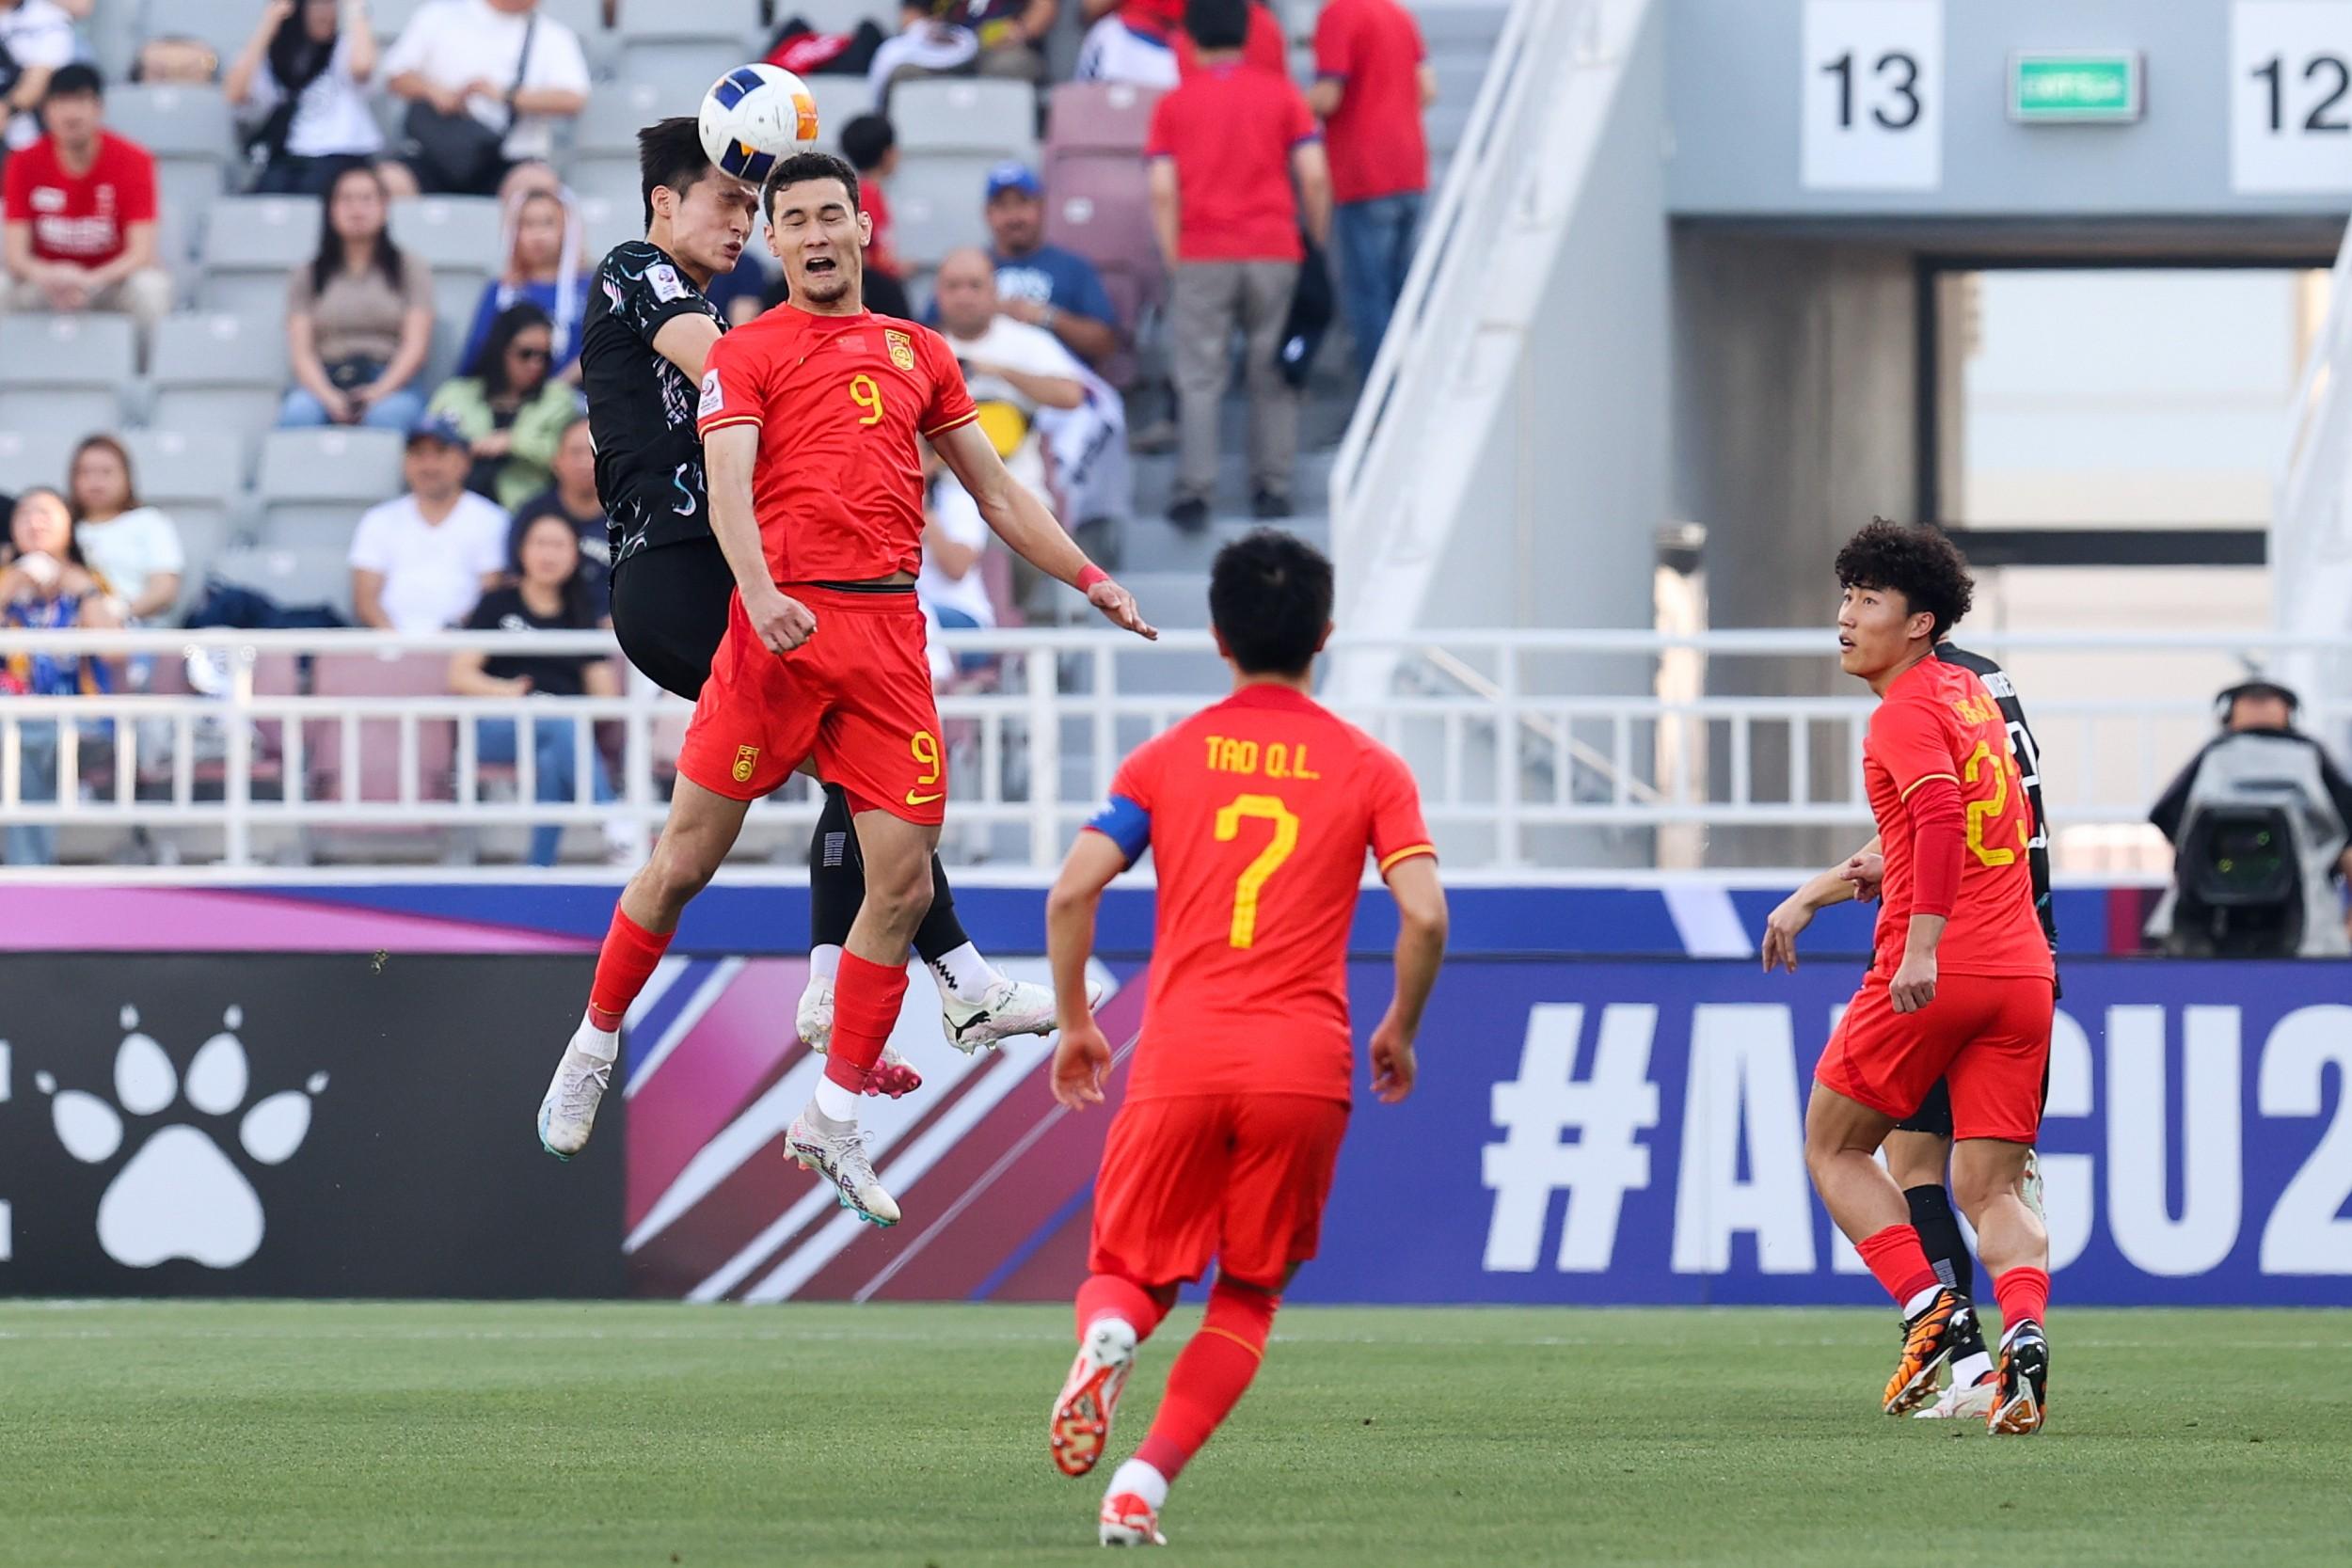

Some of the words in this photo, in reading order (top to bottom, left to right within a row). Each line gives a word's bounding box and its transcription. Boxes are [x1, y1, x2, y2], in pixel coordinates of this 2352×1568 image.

[1820, 52, 1923, 131] 13
[2251, 56, 2350, 132] 12
[849, 373, 883, 425] 9
[911, 730, 940, 784] 9
[1204, 736, 1259, 775] TAO
[1215, 793, 1300, 949] 7
